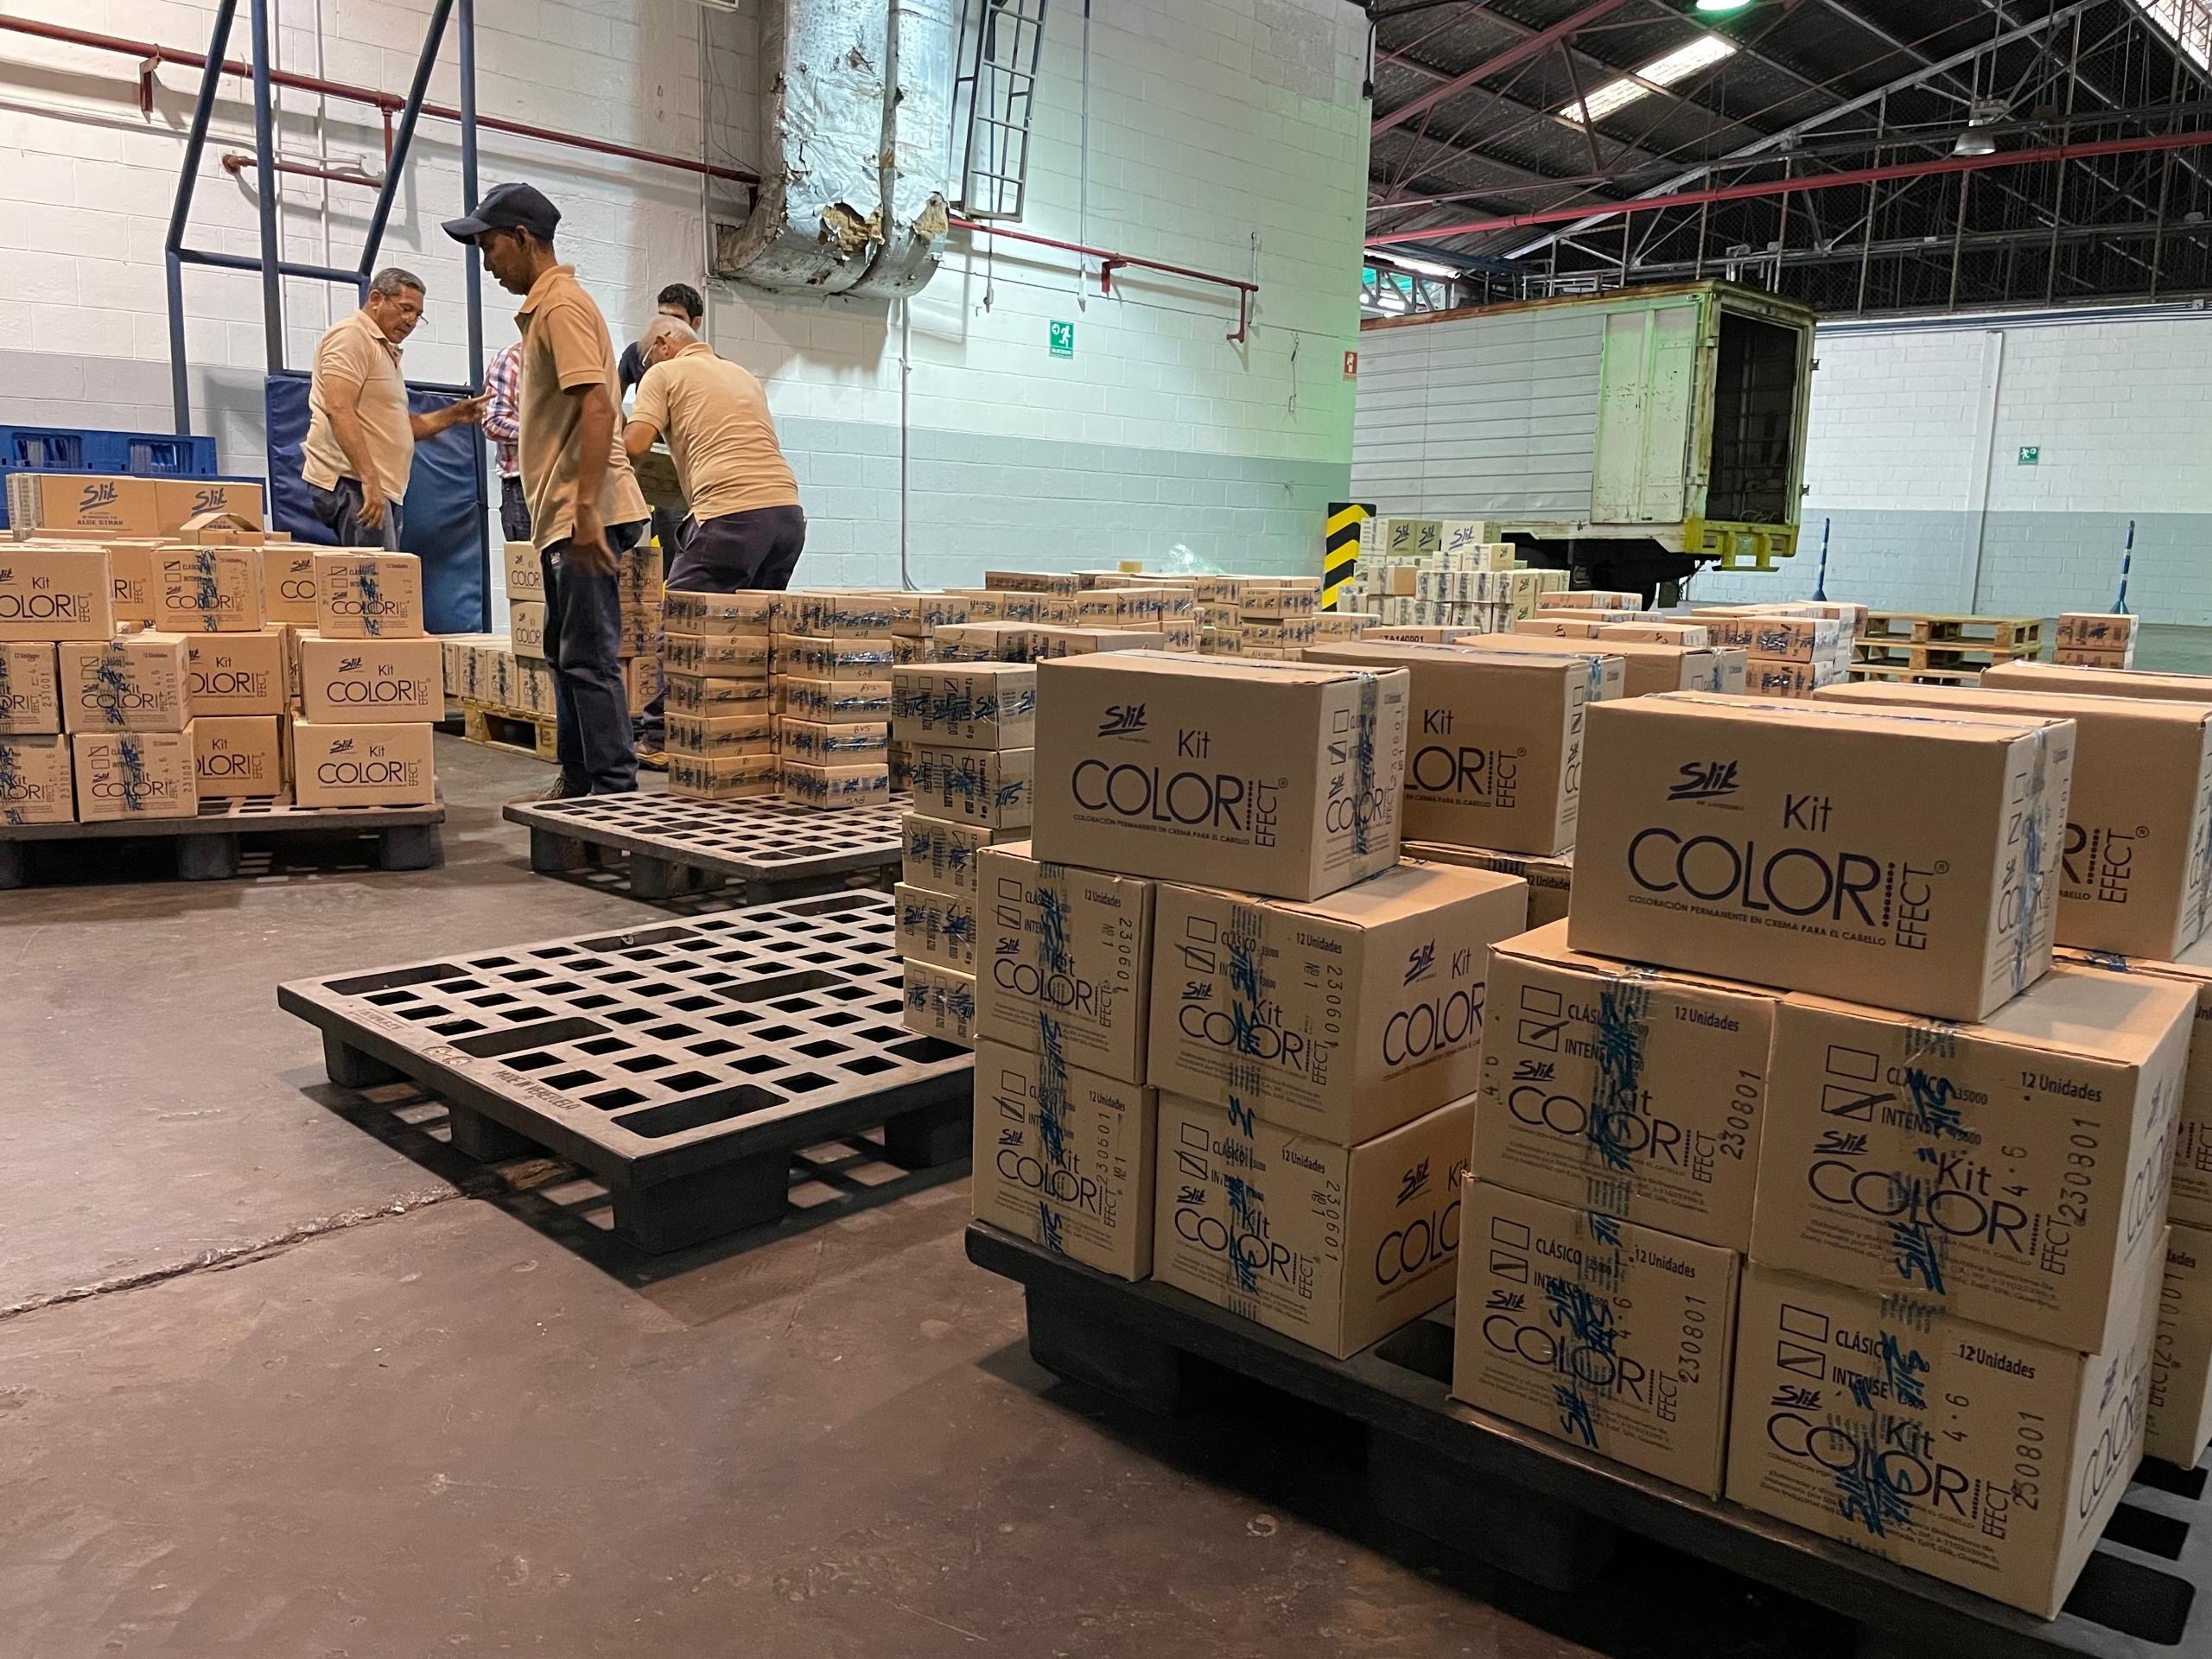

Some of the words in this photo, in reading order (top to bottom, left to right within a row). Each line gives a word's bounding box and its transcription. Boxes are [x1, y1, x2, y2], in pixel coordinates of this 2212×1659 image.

[79, 481, 118, 512] Slik
[191, 487, 228, 517] Slik
[1392, 523, 1409, 547] Slik
[1419, 524, 1435, 547] Slik
[1449, 525, 1475, 550] Slik
[0, 568, 15, 582] lik
[32, 576, 49, 588] Kit
[0, 594, 72, 618] OLOR
[216, 657, 232, 668] Kit
[339, 657, 363, 672] Slik
[378, 664, 394, 677] Kit
[191, 672, 251, 693] OLOR
[327, 681, 412, 702] COLOR
[82, 694, 154, 709] COLOR
[1098, 702, 1148, 737] Slik
[1424, 709, 1454, 734] Kit
[213, 739, 227, 750] Kit
[329, 739, 353, 753] Slik
[370, 747, 385, 757] Kit
[1178, 729, 1211, 760] Kit
[318, 762, 404, 784] COLOR
[1667, 760, 1740, 801] Slik
[1072, 760, 1244, 830] COLOR
[1783, 794, 1834, 832] Kit
[1627, 828, 1880, 926] COLOR
[1084, 888, 1091, 900] 12
[1092, 891, 1122, 908] Unidades
[1629, 895, 1687, 912] COLORACIÓN
[1690, 906, 1748, 923] PERMANENTE
[1751, 916, 1763, 925] EN
[1765, 918, 1798, 931] CREMA
[1802, 924, 1826, 936] PARA
[1829, 930, 1839, 938] EL
[1842, 931, 1886, 946] CABELLO
[995, 938, 1020, 954] Slik
[1117, 917, 1133, 995] 230601
[1296, 931, 1305, 946] 12
[1306, 934, 1343, 955] Unidades
[1403, 938, 1435, 987] Slik
[1452, 947, 1471, 980] Kit
[994, 957, 1093, 1015] COLOR
[1181, 981, 1213, 1000] Slik
[1255, 999, 1283, 1028] Kit
[1325, 966, 1344, 1048] 230601
[1675, 1007, 1687, 1020] 12
[1688, 1009, 1740, 1033] Unidades
[1383, 982, 1485, 1066] COLOR
[1513, 1060, 1555, 1081] Slik
[2020, 1071, 2036, 1089] 12
[2039, 1076, 2102, 1103] Unidades
[1090, 1091, 1096, 1103] 12
[1097, 1094, 1125, 1113] Unidades
[1719, 1070, 1761, 1160] 230801
[999, 1129, 1023, 1145] Slik
[1096, 1112, 1111, 1185] 230601
[1813, 1131, 1869, 1155] Slik
[1282, 1149, 1290, 1161] 12
[1291, 1153, 1325, 1174] Unidades
[1939, 1153, 1993, 1197] Kit
[2057, 1116, 2101, 1224] 230801
[997, 1149, 1097, 1213] COLOR
[1177, 1185, 1206, 1205] Slik
[1396, 1157, 1429, 1208] Slik
[1324, 1179, 1340, 1262] 230601
[1808, 1160, 2028, 1254] COLOR
[1376, 1200, 1460, 1285] COLO
[1535, 1238, 1581, 1266] CLÁSICO
[1635, 1249, 1647, 1264] 12
[1649, 1252, 1696, 1279] Unidades
[1486, 1289, 1527, 1313] Slik
[1679, 1295, 1707, 1383] 230801
[1835, 1330, 1885, 1359] CLÁSIC
[1483, 1314, 1645, 1402] COLOR
[1959, 1343, 1974, 1363] 12
[1976, 1348, 2036, 1380] Unidades
[1770, 1385, 1824, 1411] Slik
[1885, 1414, 1936, 1460] Kit
[2012, 1410, 2045, 1511] 230801
